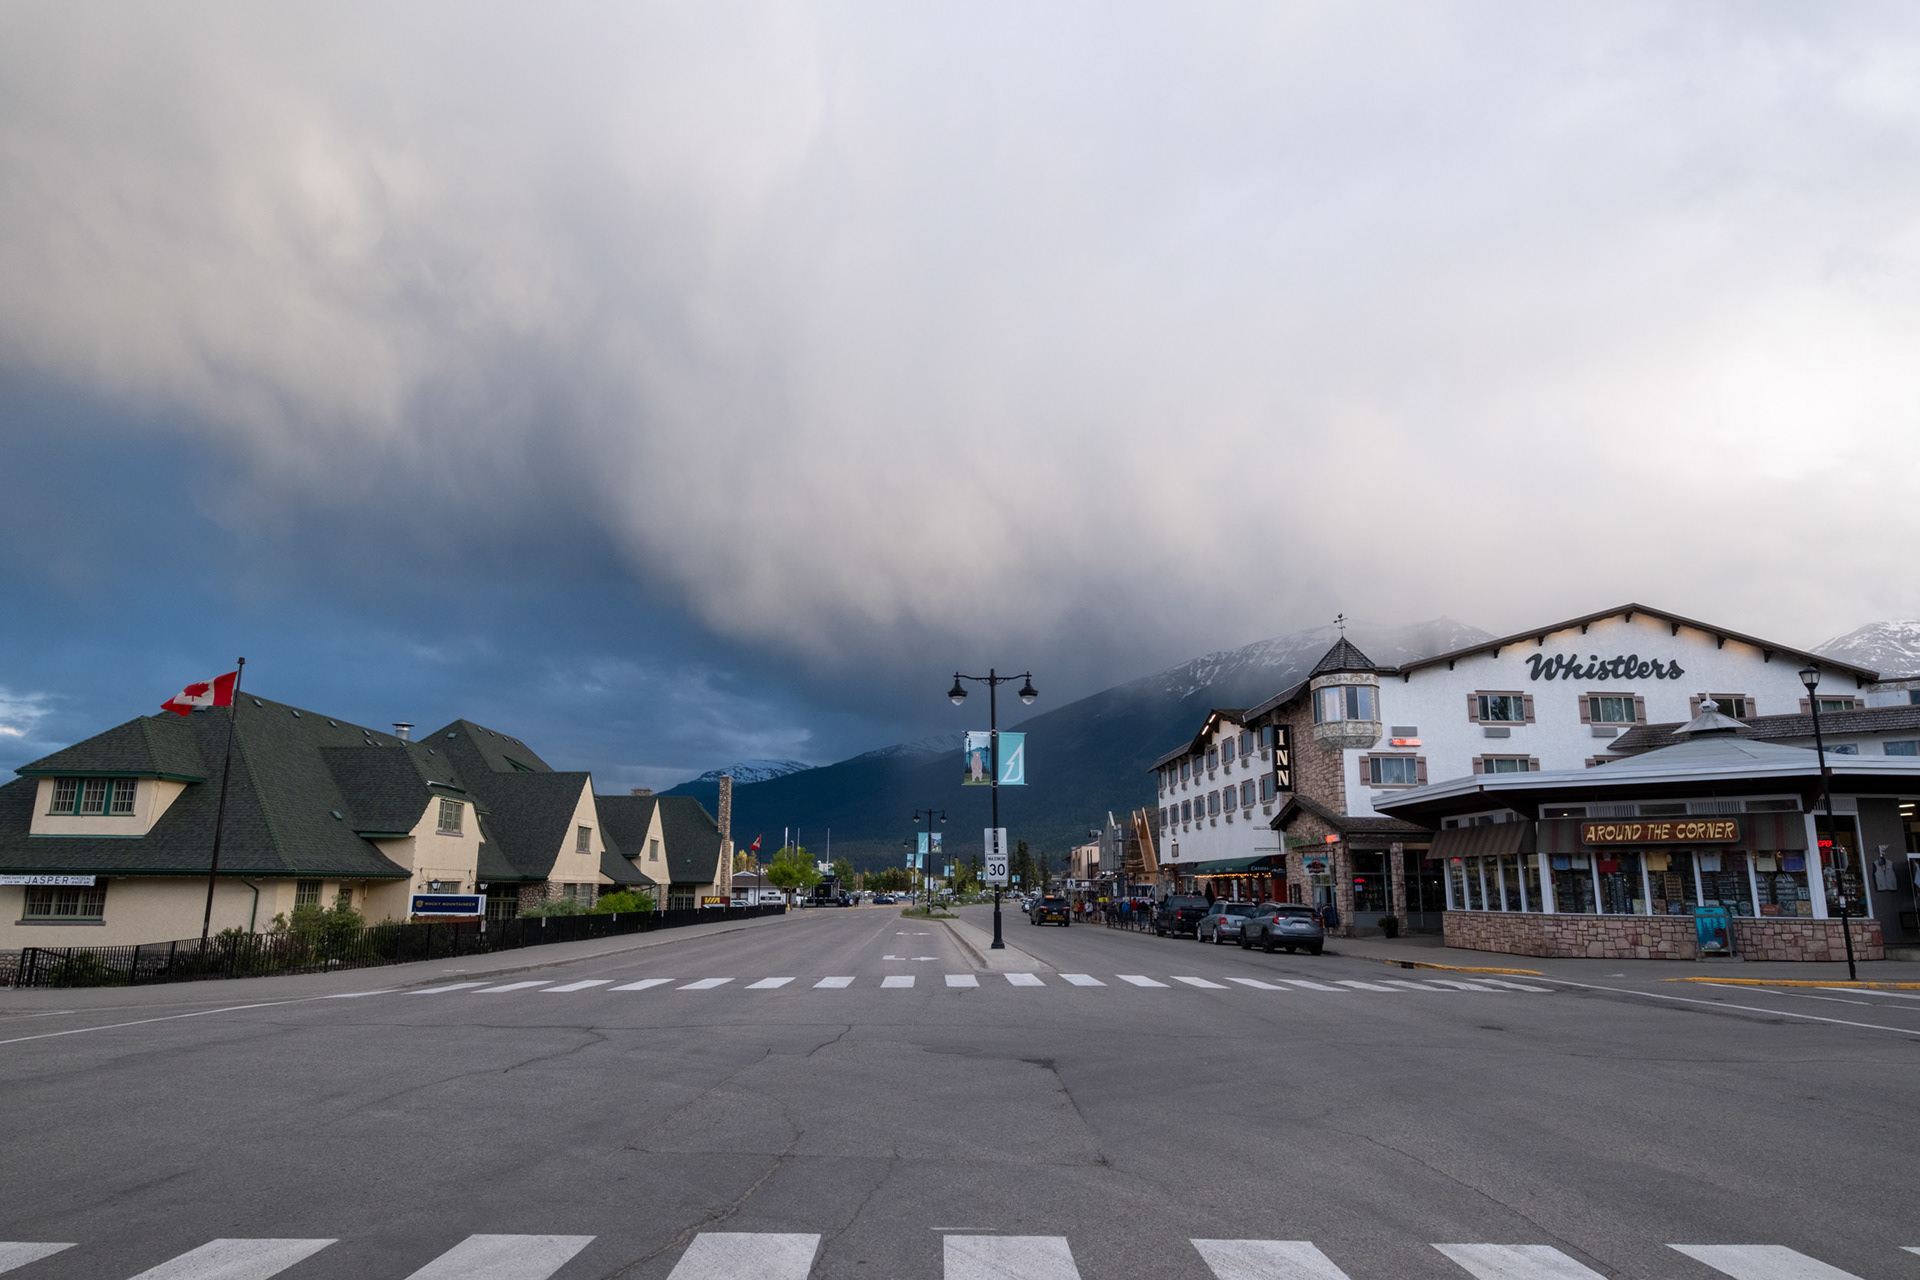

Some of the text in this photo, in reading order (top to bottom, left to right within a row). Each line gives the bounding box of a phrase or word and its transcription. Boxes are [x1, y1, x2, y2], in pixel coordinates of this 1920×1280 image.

[1525, 653, 1685, 681] Whistlers
[1276, 729, 1289, 786] INN
[1585, 821, 1735, 841] AROUND THE CORNER
[1818, 840, 1832, 848] OPEN
[989, 863, 1006, 876] 30
[24, 876, 69, 884] JASPER
